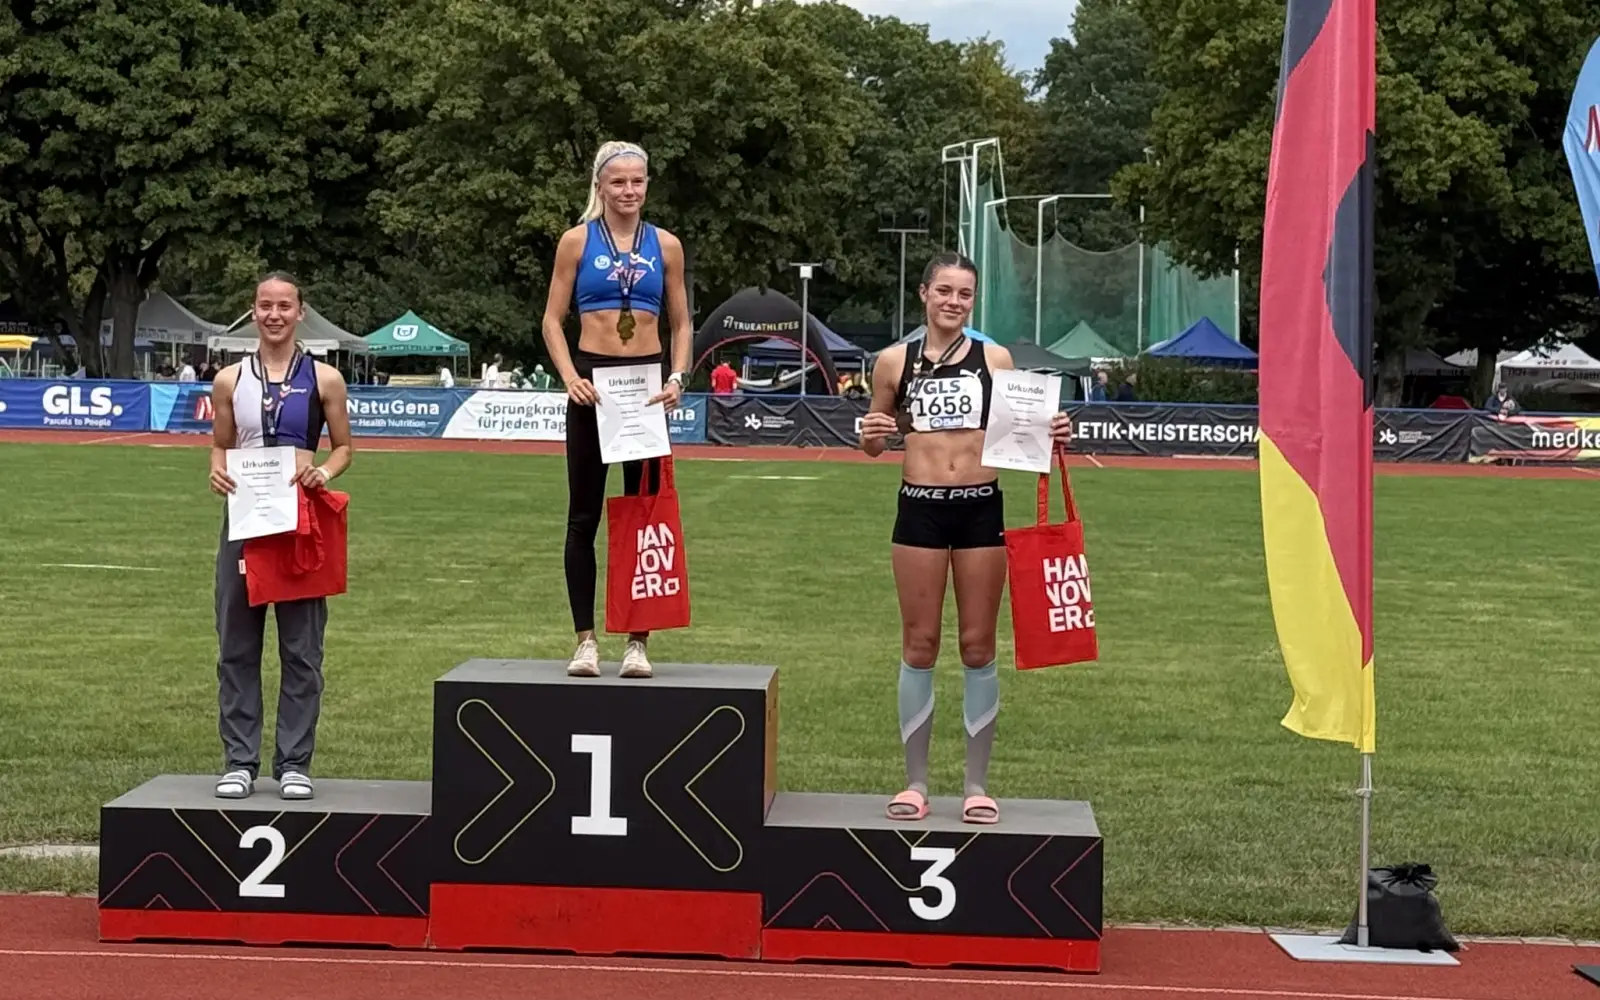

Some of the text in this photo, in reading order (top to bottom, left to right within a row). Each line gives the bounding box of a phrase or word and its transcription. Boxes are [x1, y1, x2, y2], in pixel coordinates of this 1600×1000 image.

[733, 320, 800, 332] TRUEATHLETES
[608, 376, 646, 387] Urkunde
[923, 380, 961, 395] GLS
[1007, 382, 1045, 395] Urkunde
[42, 385, 123, 416] GLS.
[346, 399, 440, 415] NatuGena
[915, 394, 972, 417] 1658
[484, 402, 567, 418] Sprungkraft
[43, 417, 112, 428] Parcels to People
[358, 418, 426, 428] Health Nutrition
[478, 416, 567, 433] für jeden Tag
[242, 459, 280, 469] Urkunde
[901, 486, 994, 500] NIKE PRO
[571, 734, 628, 836] 1
[239, 825, 286, 898] 2
[908, 847, 957, 920] 3
